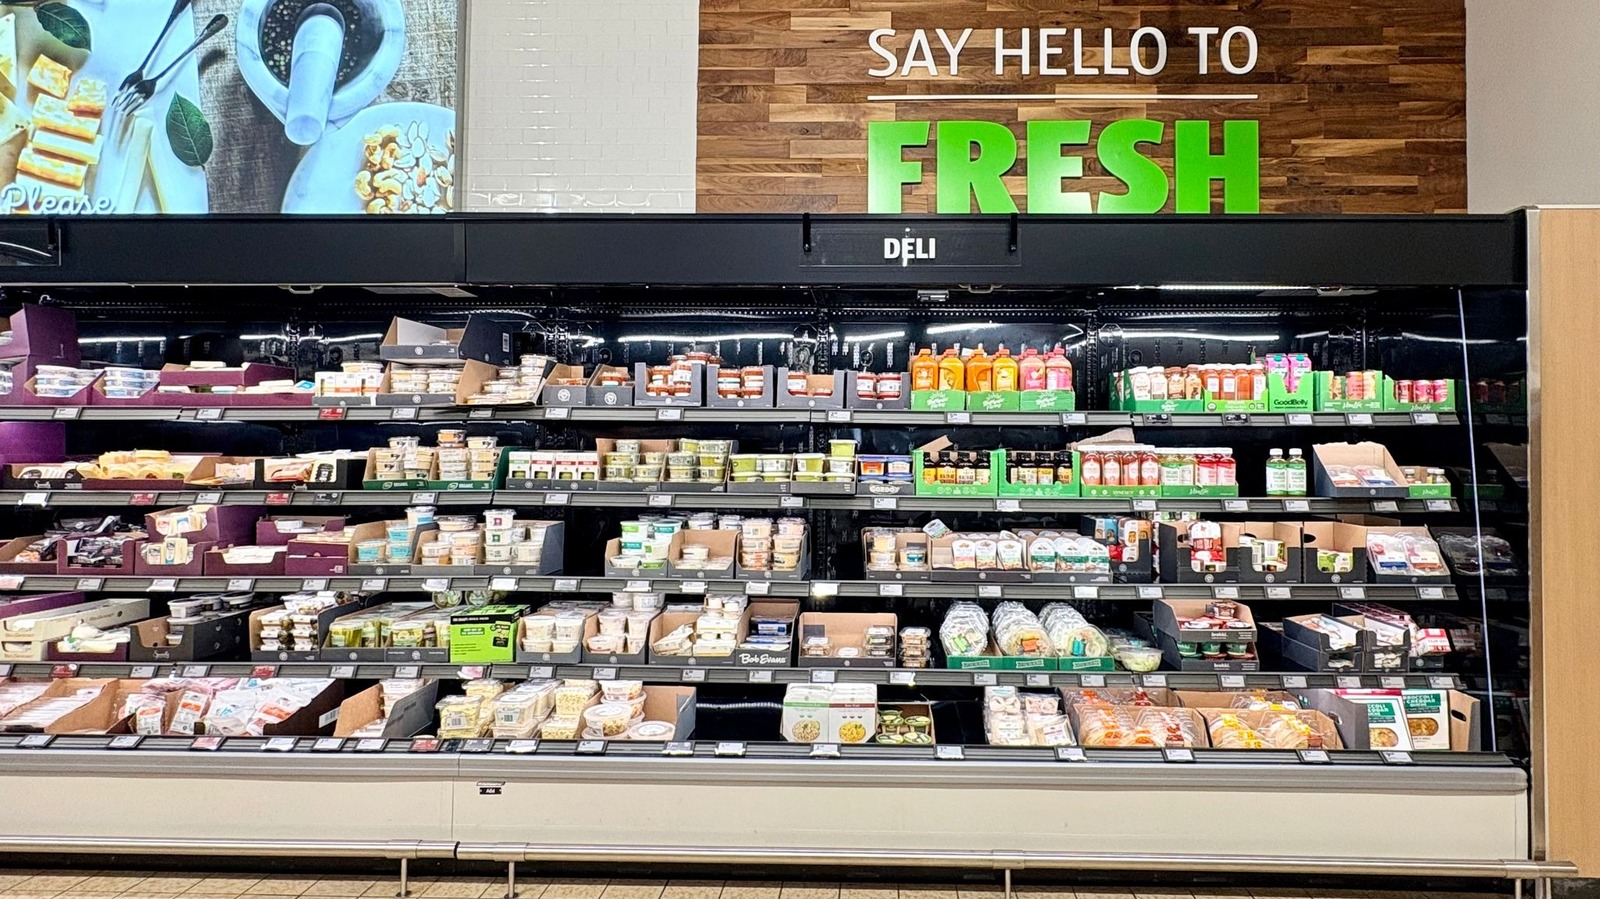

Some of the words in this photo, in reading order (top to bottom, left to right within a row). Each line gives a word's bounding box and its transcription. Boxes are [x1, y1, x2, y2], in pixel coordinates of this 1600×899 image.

[868, 28, 973, 77] SAY
[994, 26, 1167, 76] HELLO
[1187, 25, 1258, 75] TO
[868, 118, 1260, 214] FRESH
[1, 183, 116, 214] Please
[884, 237, 937, 260] DELI
[1273, 398, 1309, 407] GoodBelly
[739, 653, 759, 664] Bob
[759, 653, 787, 664] Evans
